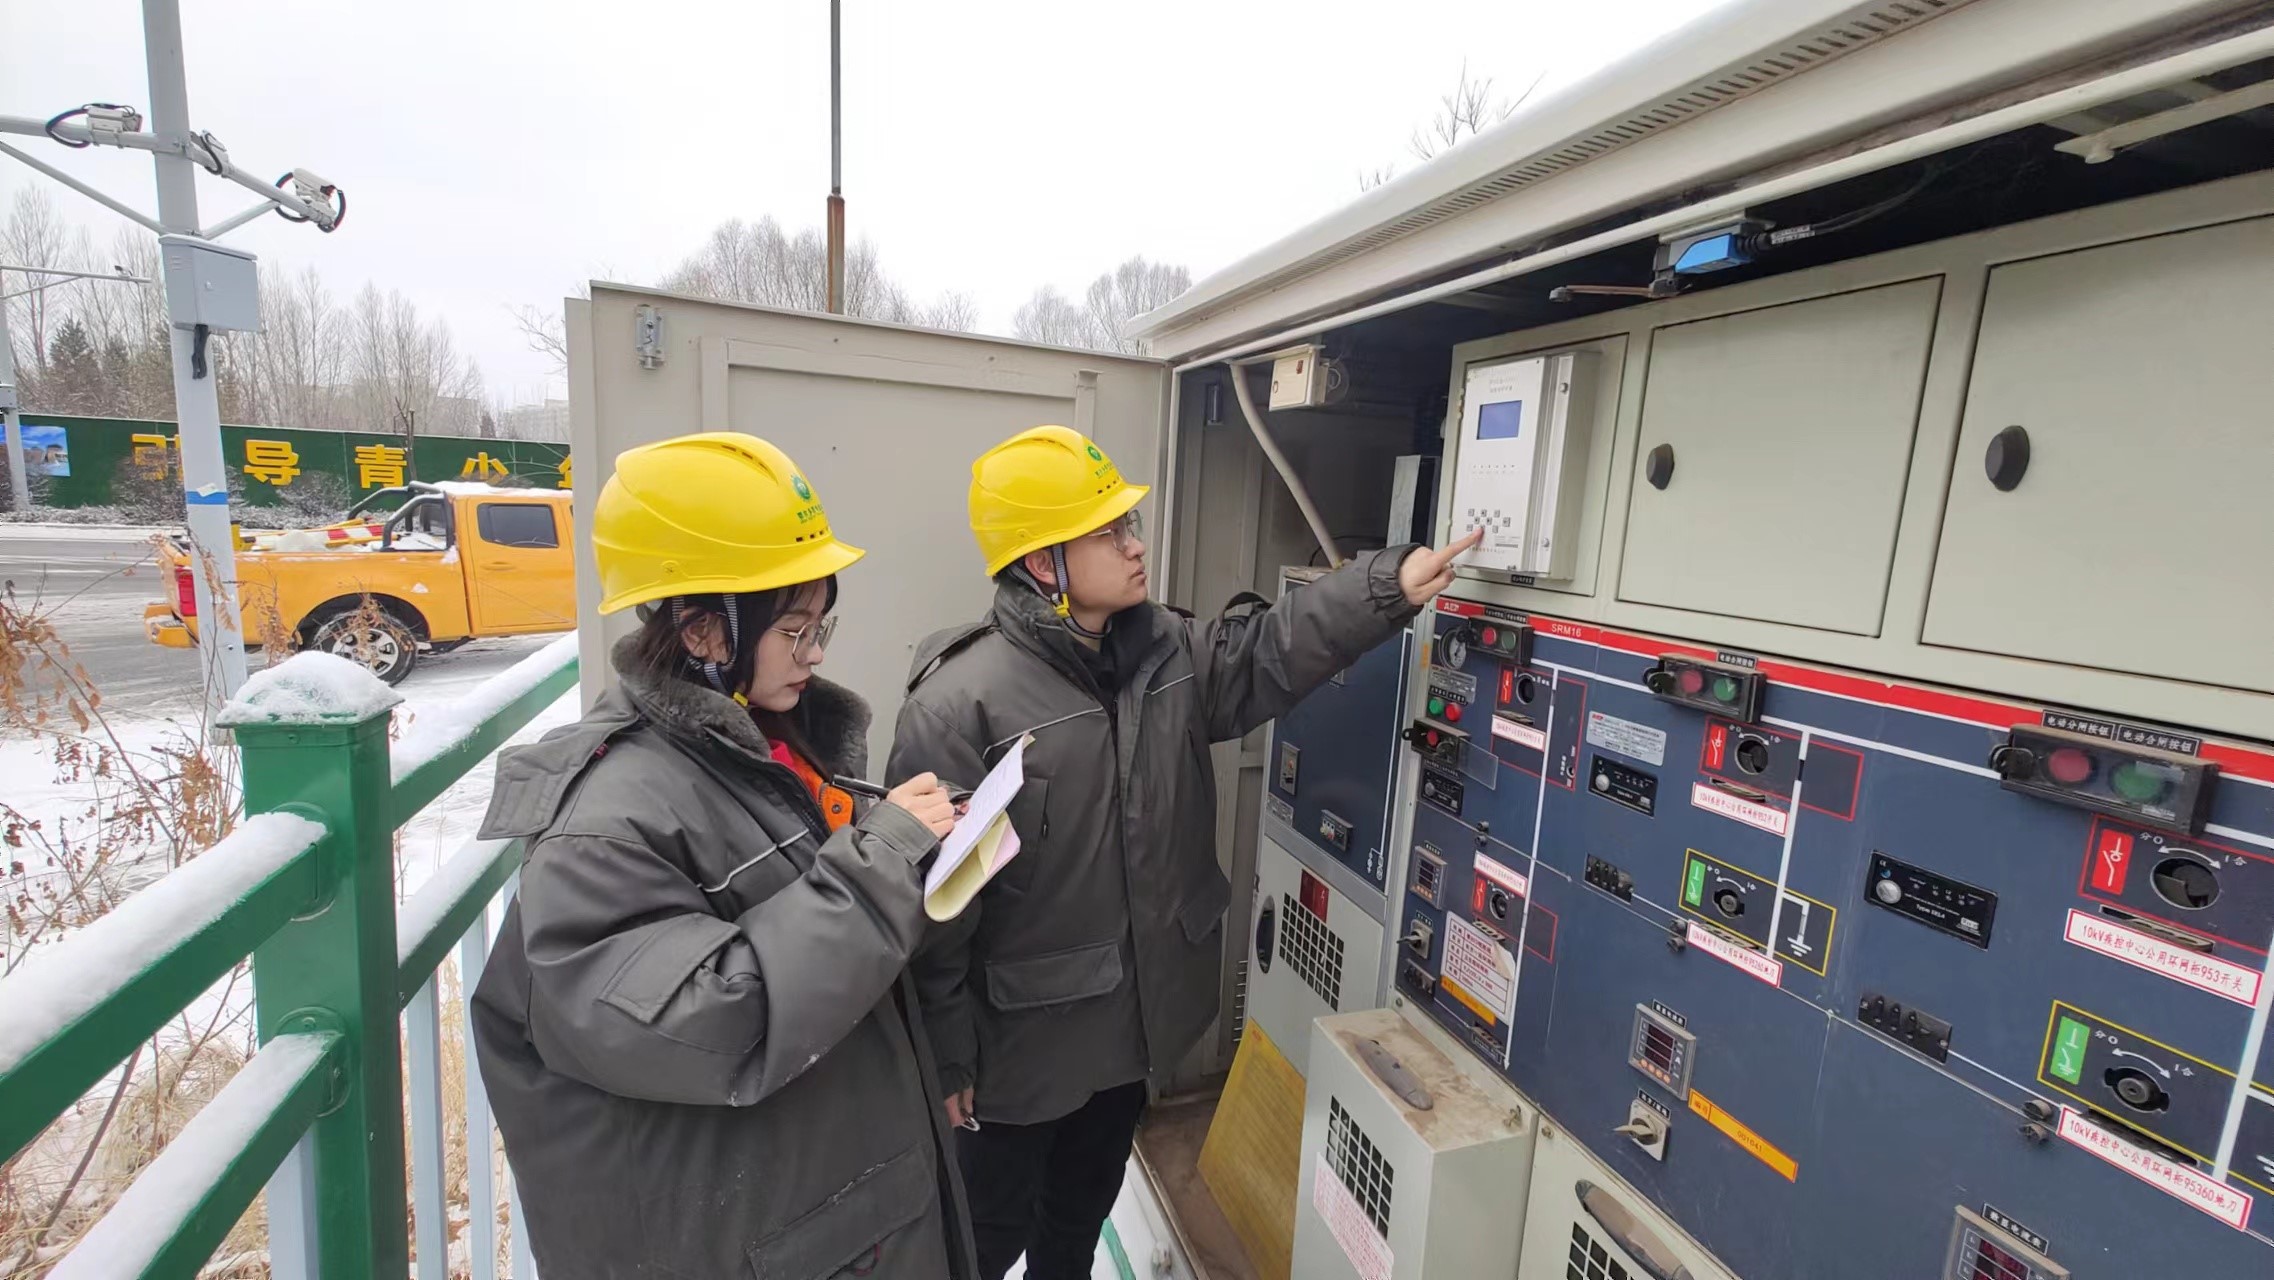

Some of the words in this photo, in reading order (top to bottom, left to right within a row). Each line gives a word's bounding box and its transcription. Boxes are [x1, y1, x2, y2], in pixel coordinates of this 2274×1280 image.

[1551, 623, 1582, 638] SRM16
[2046, 715, 2109, 737] 电动分闸按钮
[2122, 730, 2193, 753] 电动合闸按钮
[2082, 924, 2244, 993] 10kV疾控中心公用环网柜953开关
[2069, 1118, 2239, 1214] 10kV疾控中心公用环网柜95360地刀
